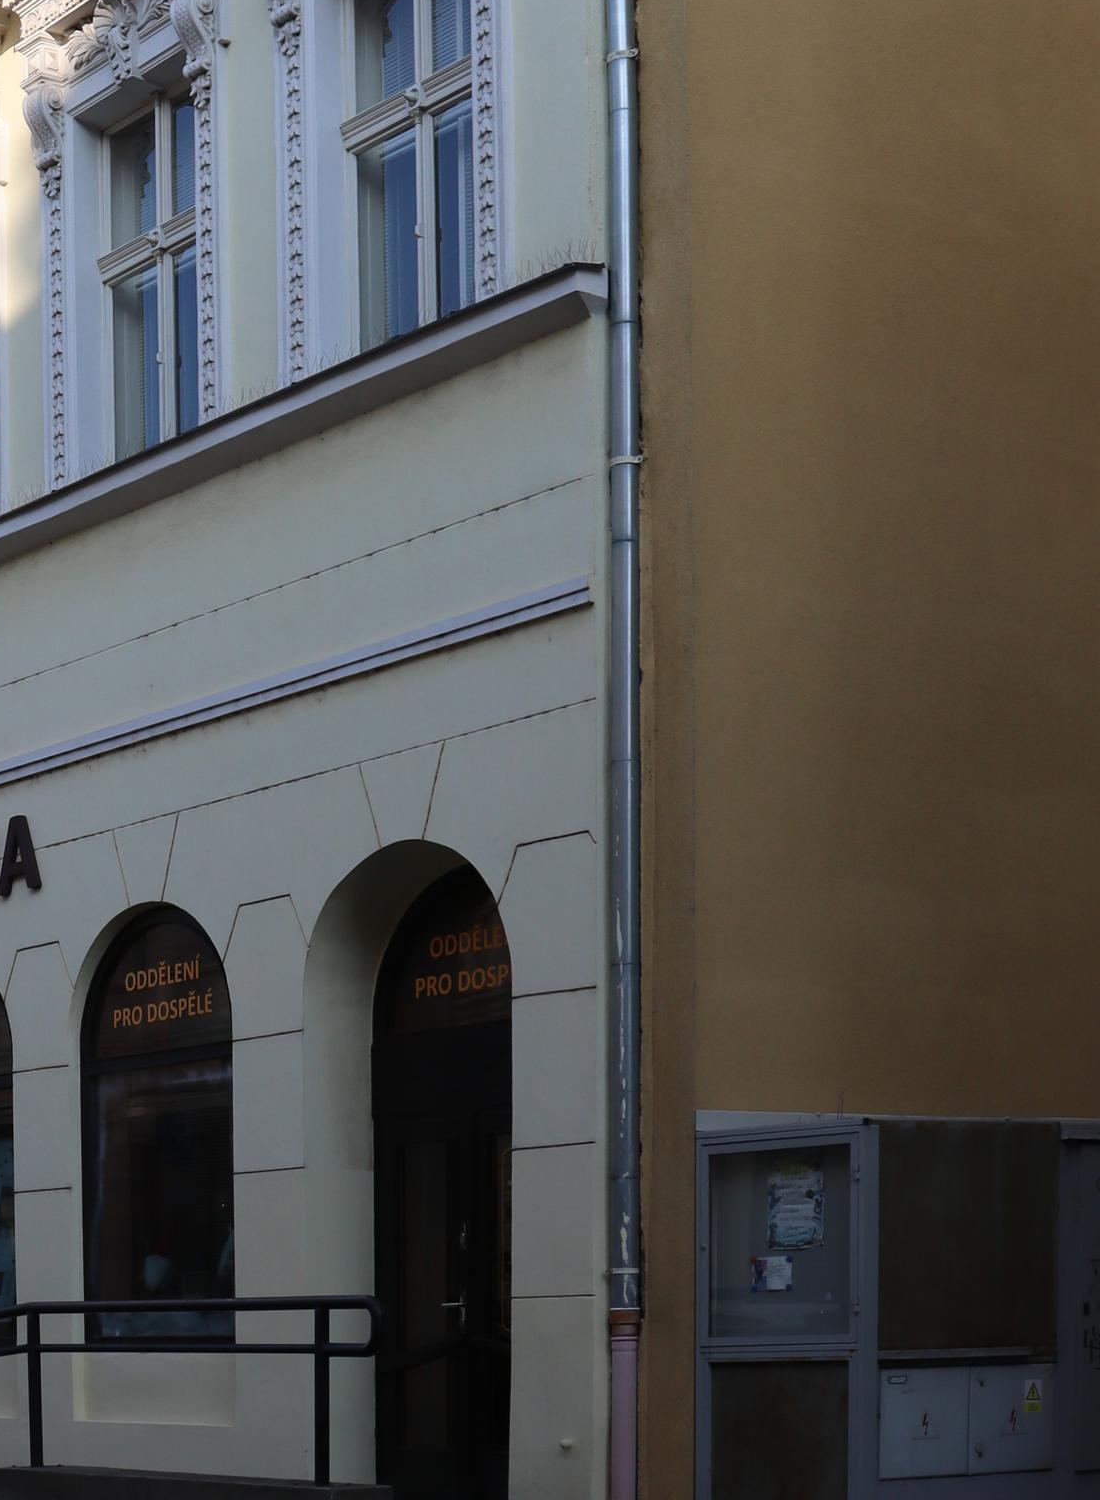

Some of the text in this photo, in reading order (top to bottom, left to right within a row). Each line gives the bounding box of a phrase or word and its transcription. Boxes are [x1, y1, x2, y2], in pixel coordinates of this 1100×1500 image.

[429, 923, 506, 959] ODDĚLE
[125, 953, 200, 992] ODDĚLENÍ
[414, 972, 452, 999] PRO
[113, 987, 213, 1029] PRO DOSPĚLÉ
